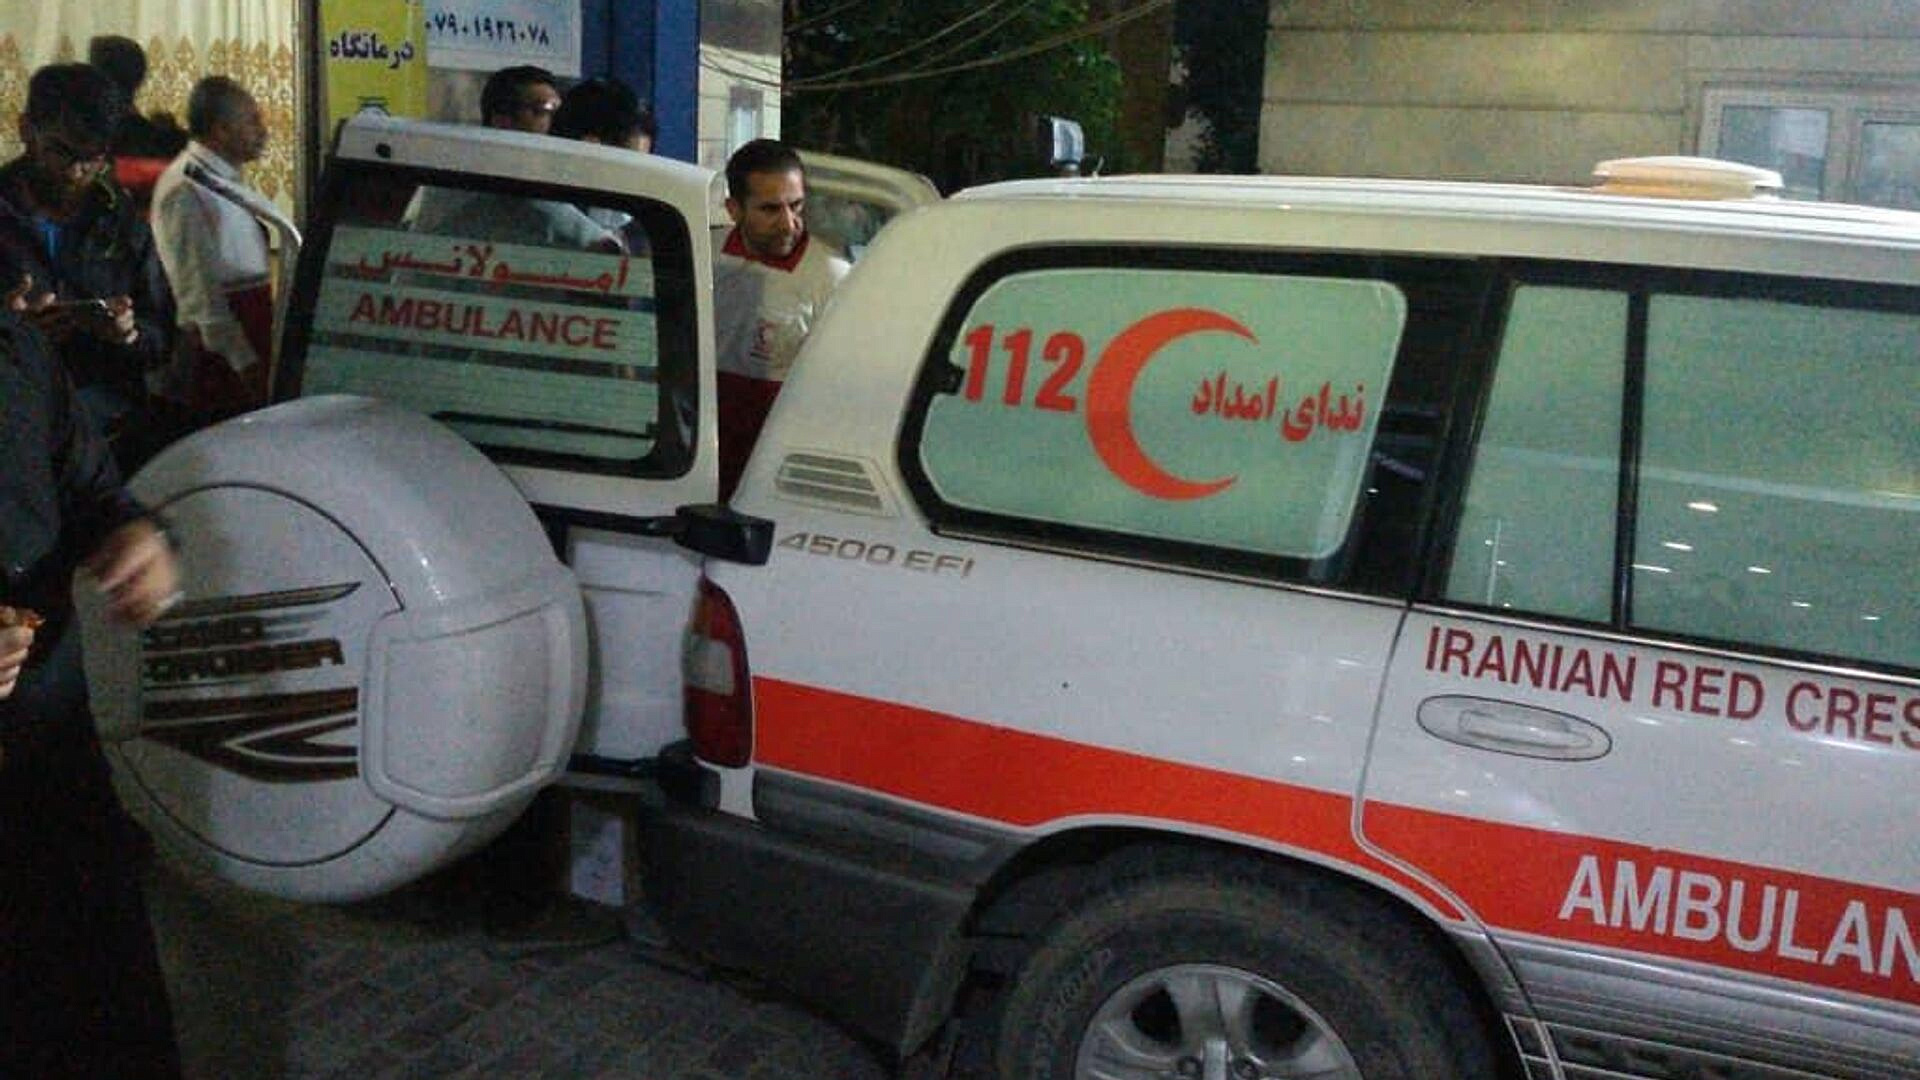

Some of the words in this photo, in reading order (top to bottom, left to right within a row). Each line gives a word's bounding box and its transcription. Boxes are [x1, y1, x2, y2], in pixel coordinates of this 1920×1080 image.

[330, 31, 414, 69] درمانگاه
[350, 293, 620, 350] AMBULANCE
[964, 324, 1085, 413] 112
[1191, 370, 1277, 421] امداد
[1281, 380, 1364, 442] ندای
[777, 532, 896, 566] 4500
[902, 549, 976, 579] EFI
[1425, 626, 1637, 702] IRANIAN
[1652, 662, 1765, 720] RED
